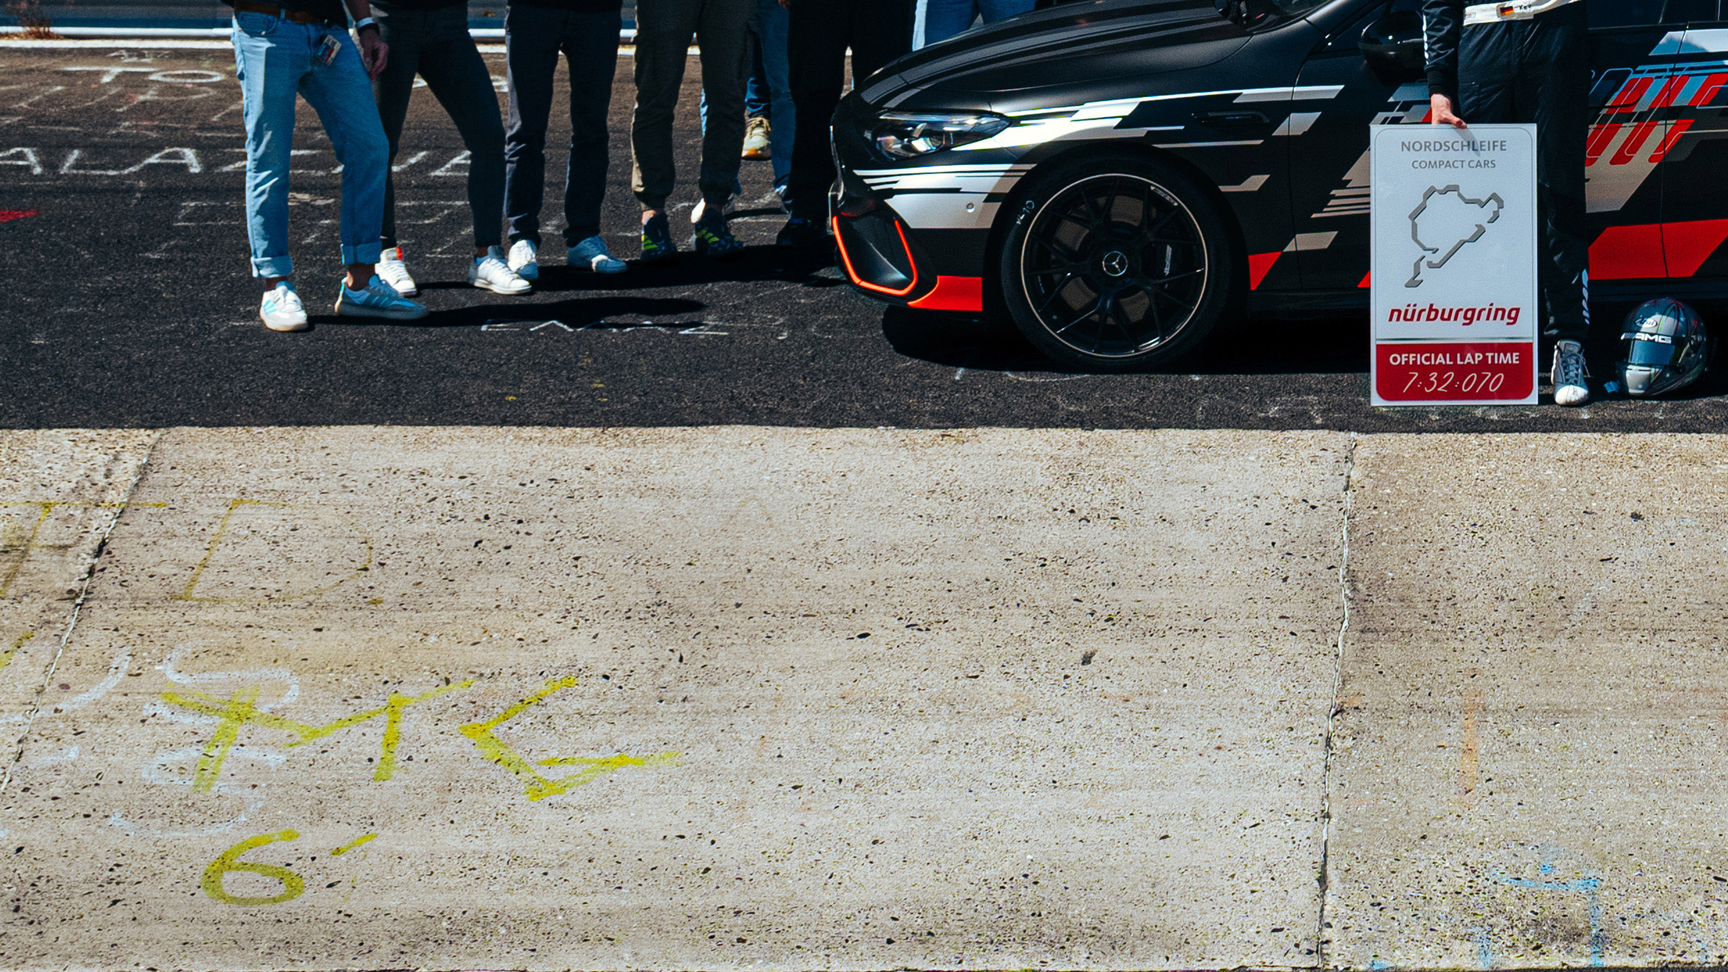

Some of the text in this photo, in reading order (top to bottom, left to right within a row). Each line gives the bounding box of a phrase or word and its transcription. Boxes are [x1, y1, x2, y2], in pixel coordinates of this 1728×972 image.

[1400, 140, 1508, 152] NORDSCHLEIFE
[1411, 159, 1496, 169] COMPACT CARS
[1388, 302, 1521, 326] nürburgring
[1633, 332, 1672, 344] AMG
[1389, 352, 1520, 366] OFFICIAL LAP TIME
[1403, 372, 1504, 394] 7:32:070
